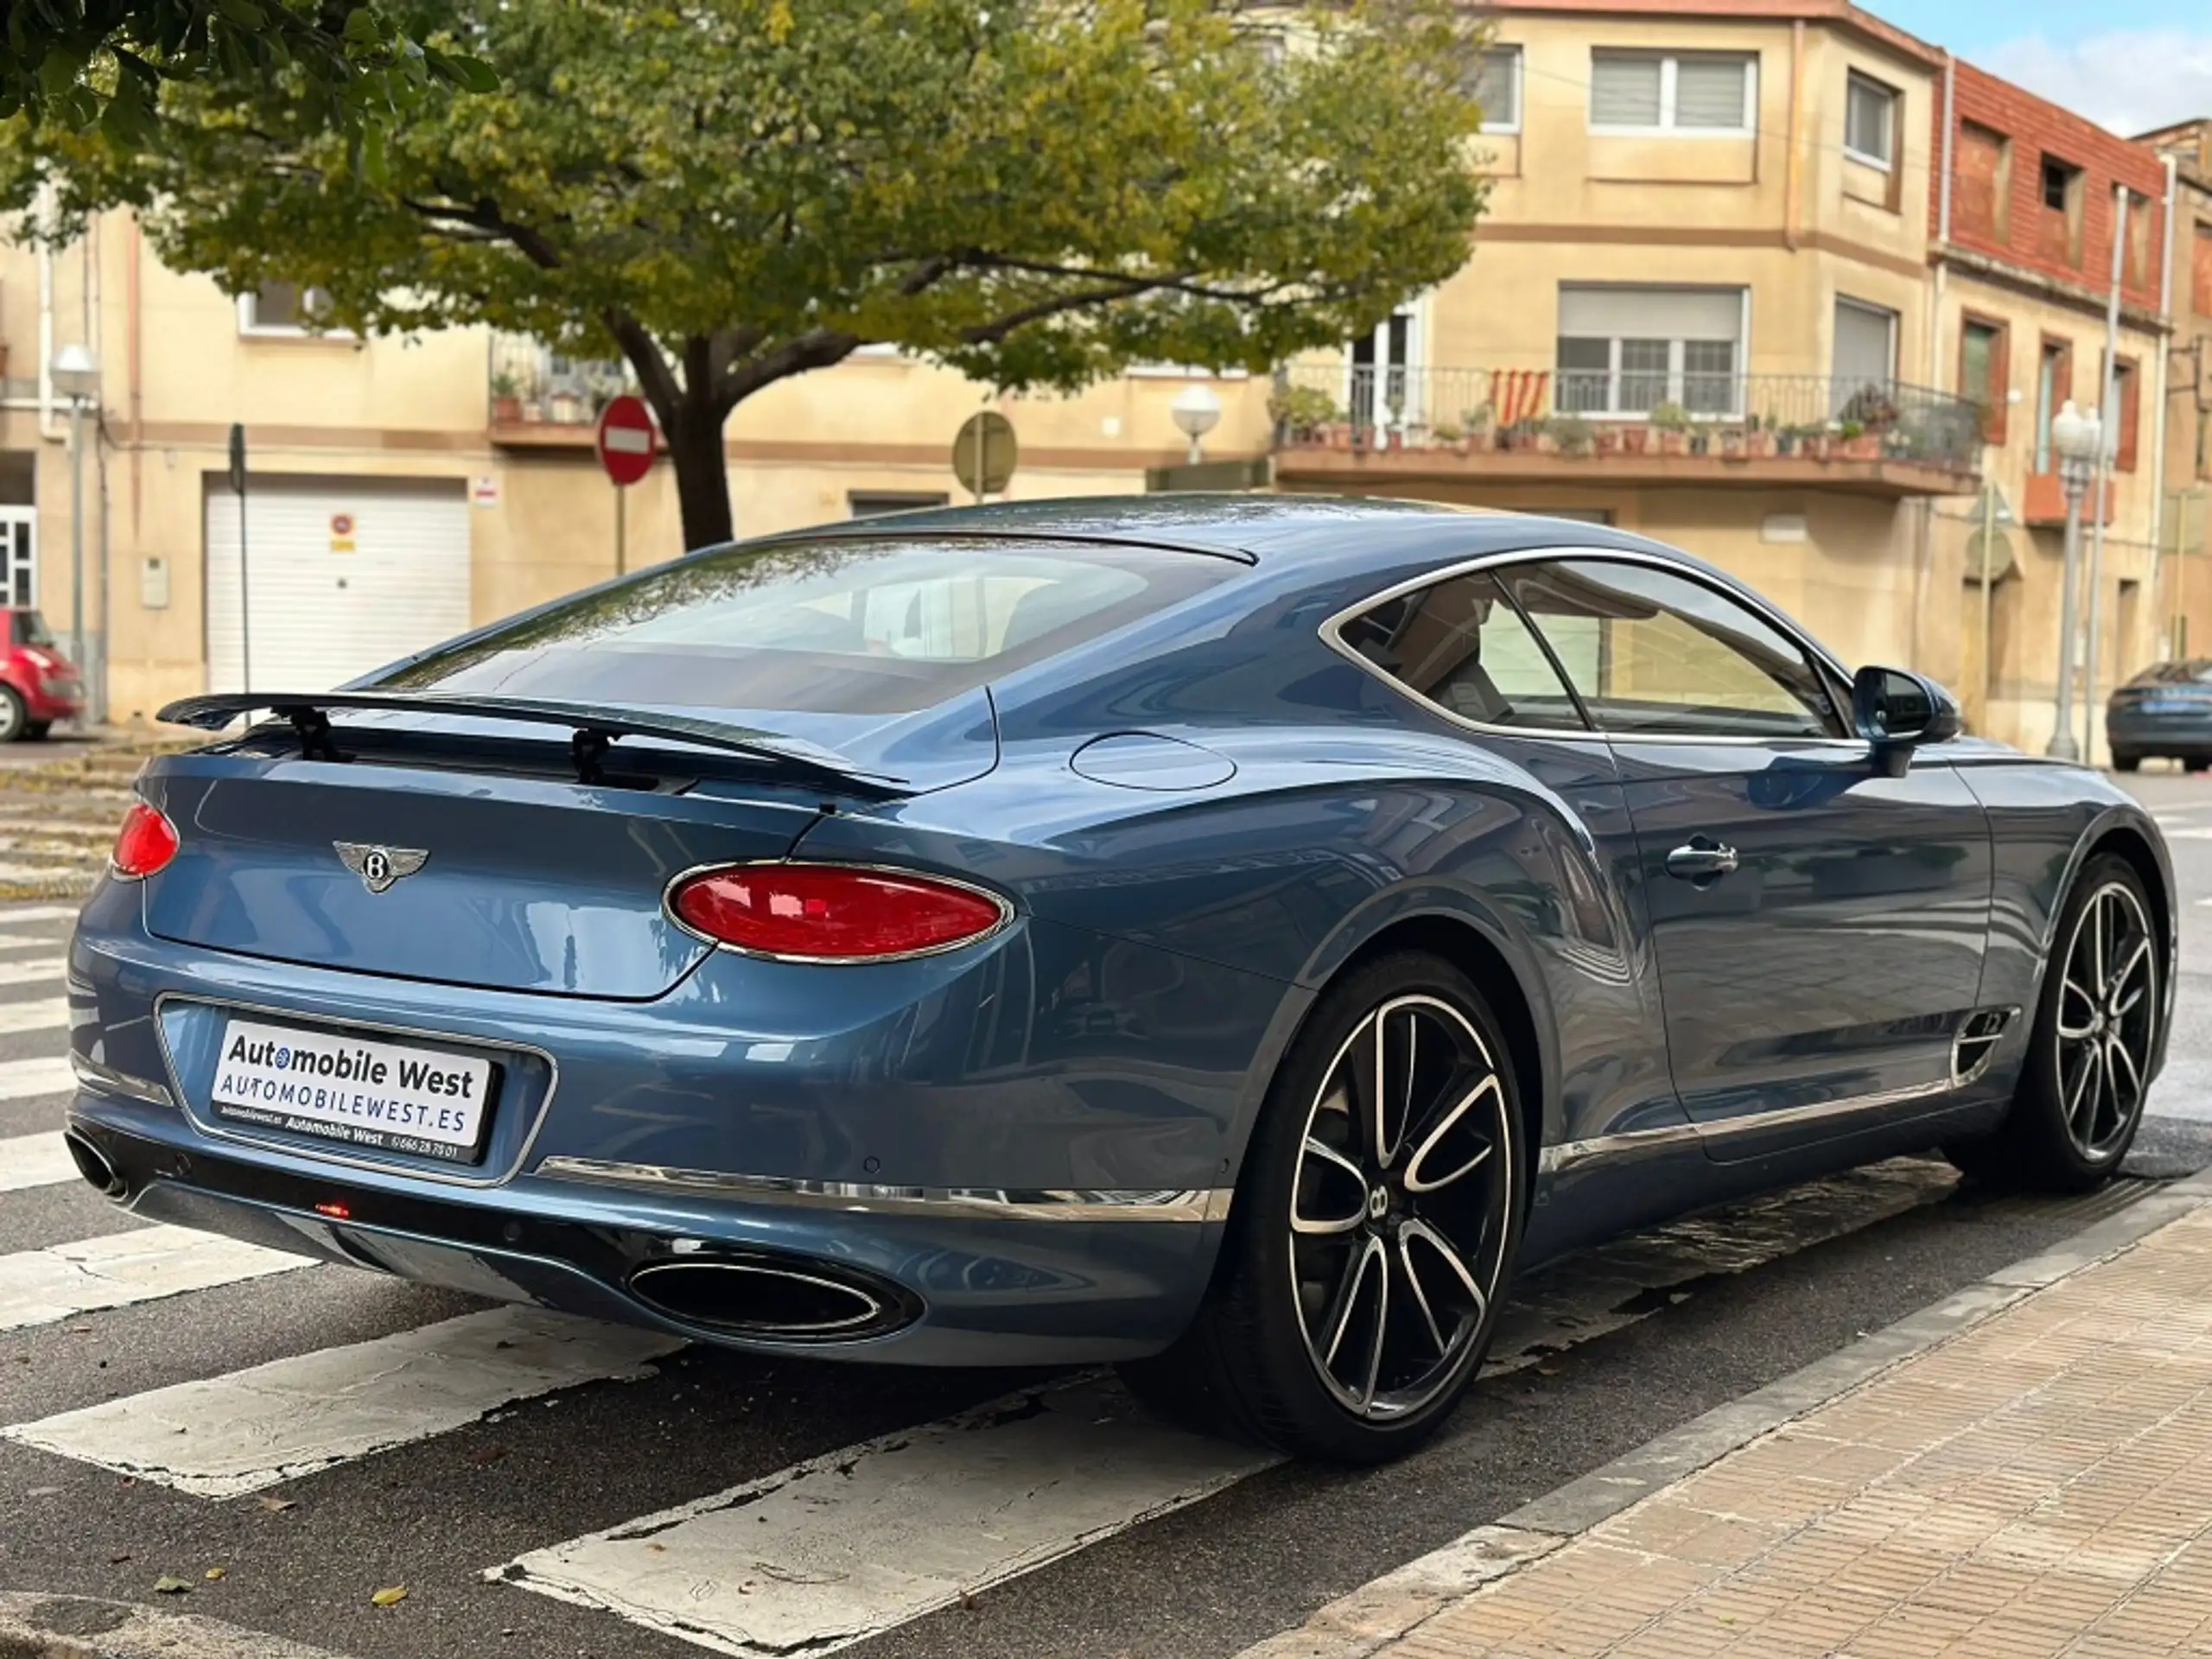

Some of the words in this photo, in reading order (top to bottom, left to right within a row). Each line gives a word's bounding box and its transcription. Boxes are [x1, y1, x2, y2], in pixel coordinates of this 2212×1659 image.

[228, 1034, 388, 1085] Automobile
[398, 1058, 474, 1098] West
[220, 1074, 465, 1132] AUTOMOBILEWEST.ES
[285, 1116, 352, 1140] Automobile
[353, 1128, 385, 1146] West
